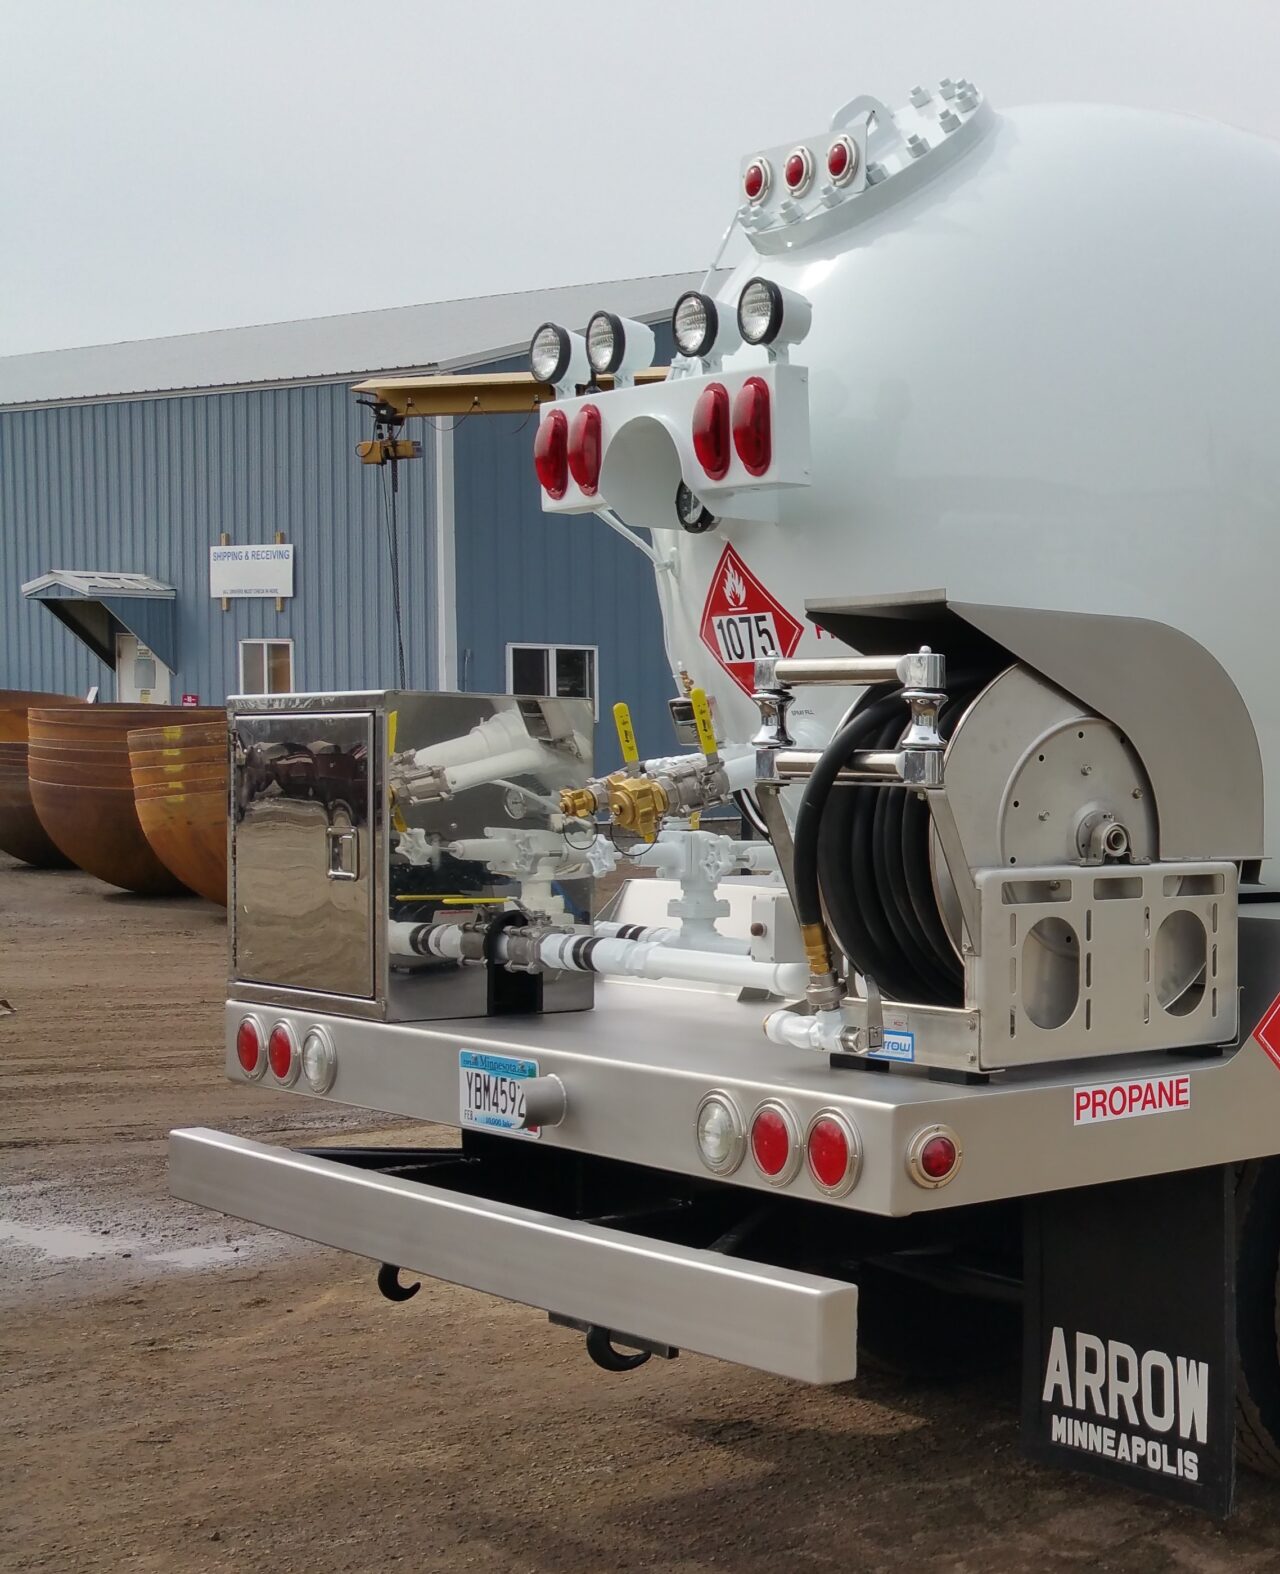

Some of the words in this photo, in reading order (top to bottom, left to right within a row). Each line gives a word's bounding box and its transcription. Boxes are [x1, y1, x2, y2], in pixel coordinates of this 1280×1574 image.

[213, 551, 242, 561] SHIPPING
[244, 552, 249, 560] &
[251, 550, 290, 560] RECEIVING
[716, 615, 776, 662] 1075
[480, 1055, 517, 1074] Minnesota
[882, 1039, 911, 1053] rrow
[1075, 1078, 1190, 1121] PROPANE
[1042, 1326, 1209, 1444] ARROW
[1052, 1414, 1199, 1481] MINNEAPOLIS
